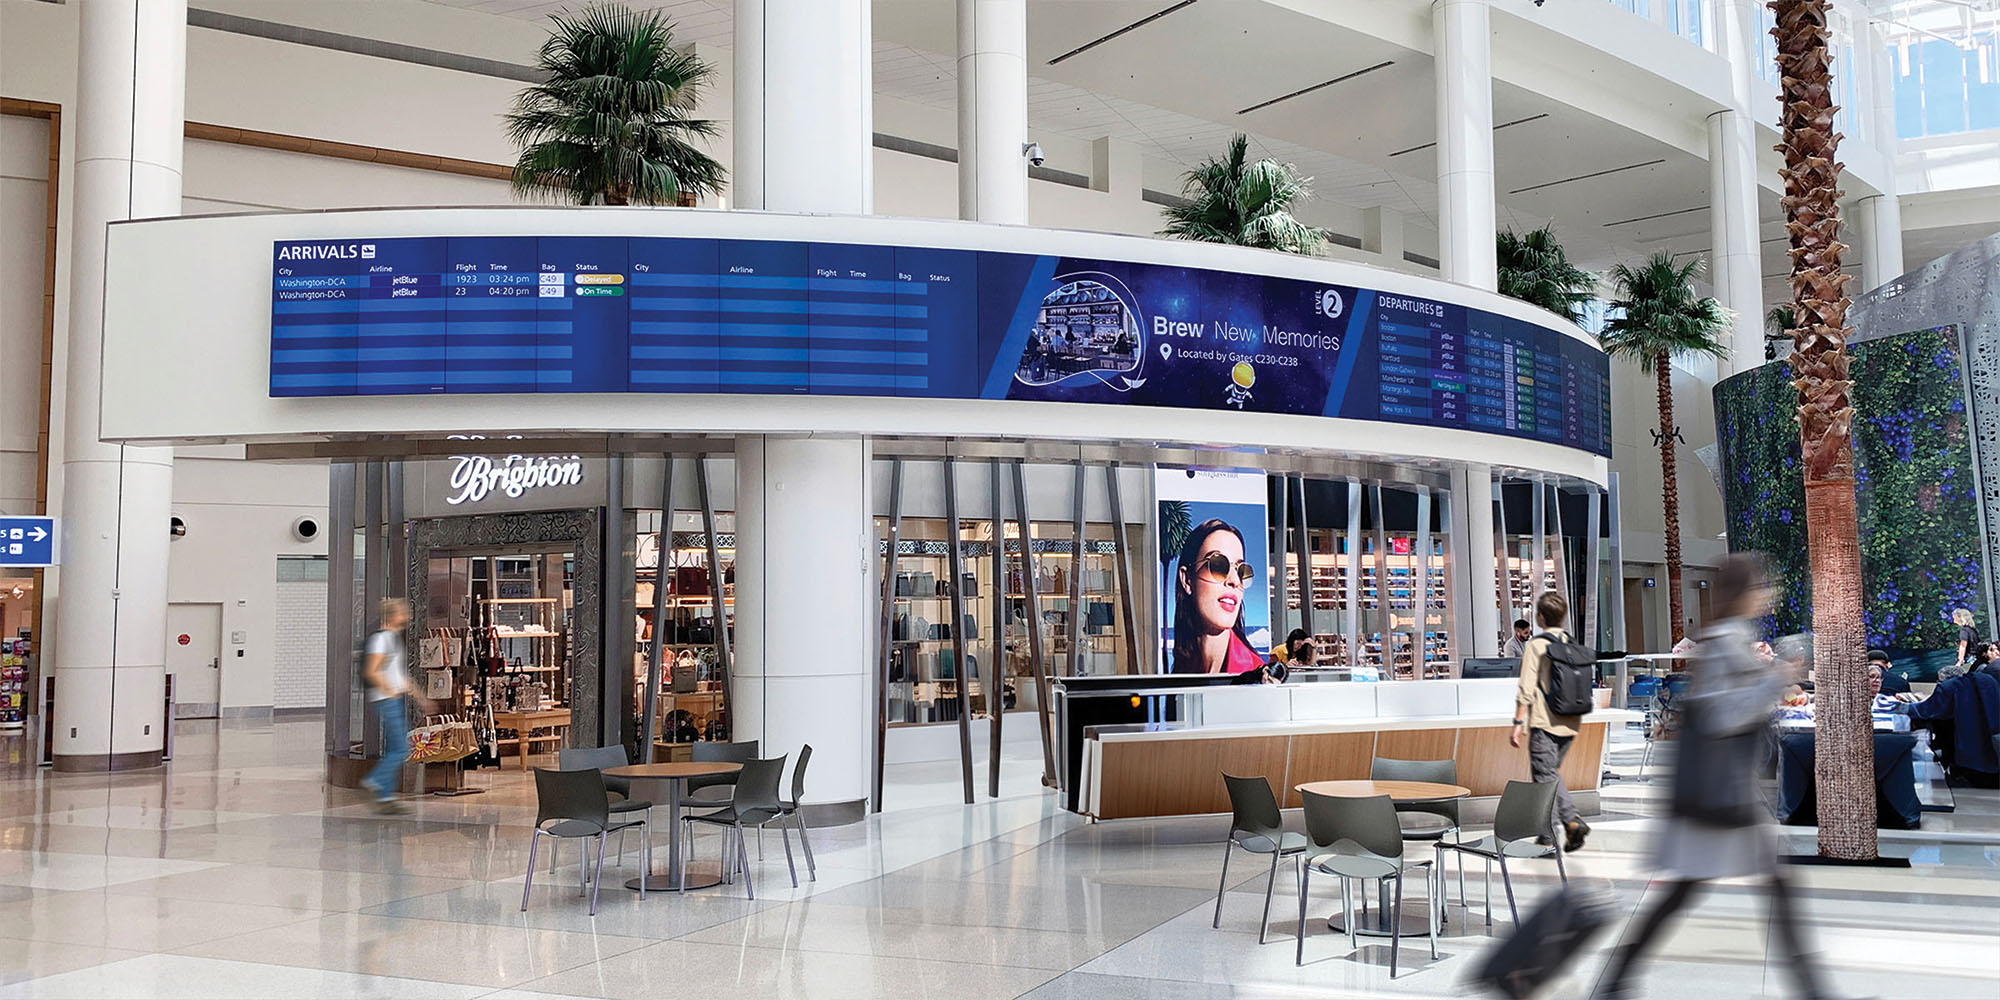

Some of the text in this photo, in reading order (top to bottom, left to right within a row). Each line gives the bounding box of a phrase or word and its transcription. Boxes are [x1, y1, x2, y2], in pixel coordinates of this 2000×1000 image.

[278, 244, 358, 260] ARRIVALS
[278, 268, 292, 276] City
[369, 265, 393, 273] Airline
[456, 264, 477, 272] Flight
[541, 264, 556, 272] Bag
[575, 263, 598, 271] Status
[634, 263, 650, 273] City
[730, 266, 754, 274] Airline
[816, 268, 838, 278] Flight
[849, 270, 867, 278] Time
[898, 273, 912, 282] Bag
[929, 274, 950, 282] Status
[279, 278, 346, 288] Washington-DCA
[392, 275, 418, 286] jetBlue
[456, 275, 477, 283] 1923
[489, 275, 530, 285] 03:24 pm
[279, 290, 346, 300] Washington-DCA
[392, 288, 418, 298] jetBlue
[455, 287, 466, 295] 23
[489, 287, 530, 297] 04:20 pm
[1327, 294, 1338, 313] 2
[1379, 295, 1435, 316] DEPARTURES
[1153, 315, 1340, 351] Brew New Memories
[1177, 348, 1298, 367] Located by Gates C230-C238
[446, 455, 582, 505] Brighton
